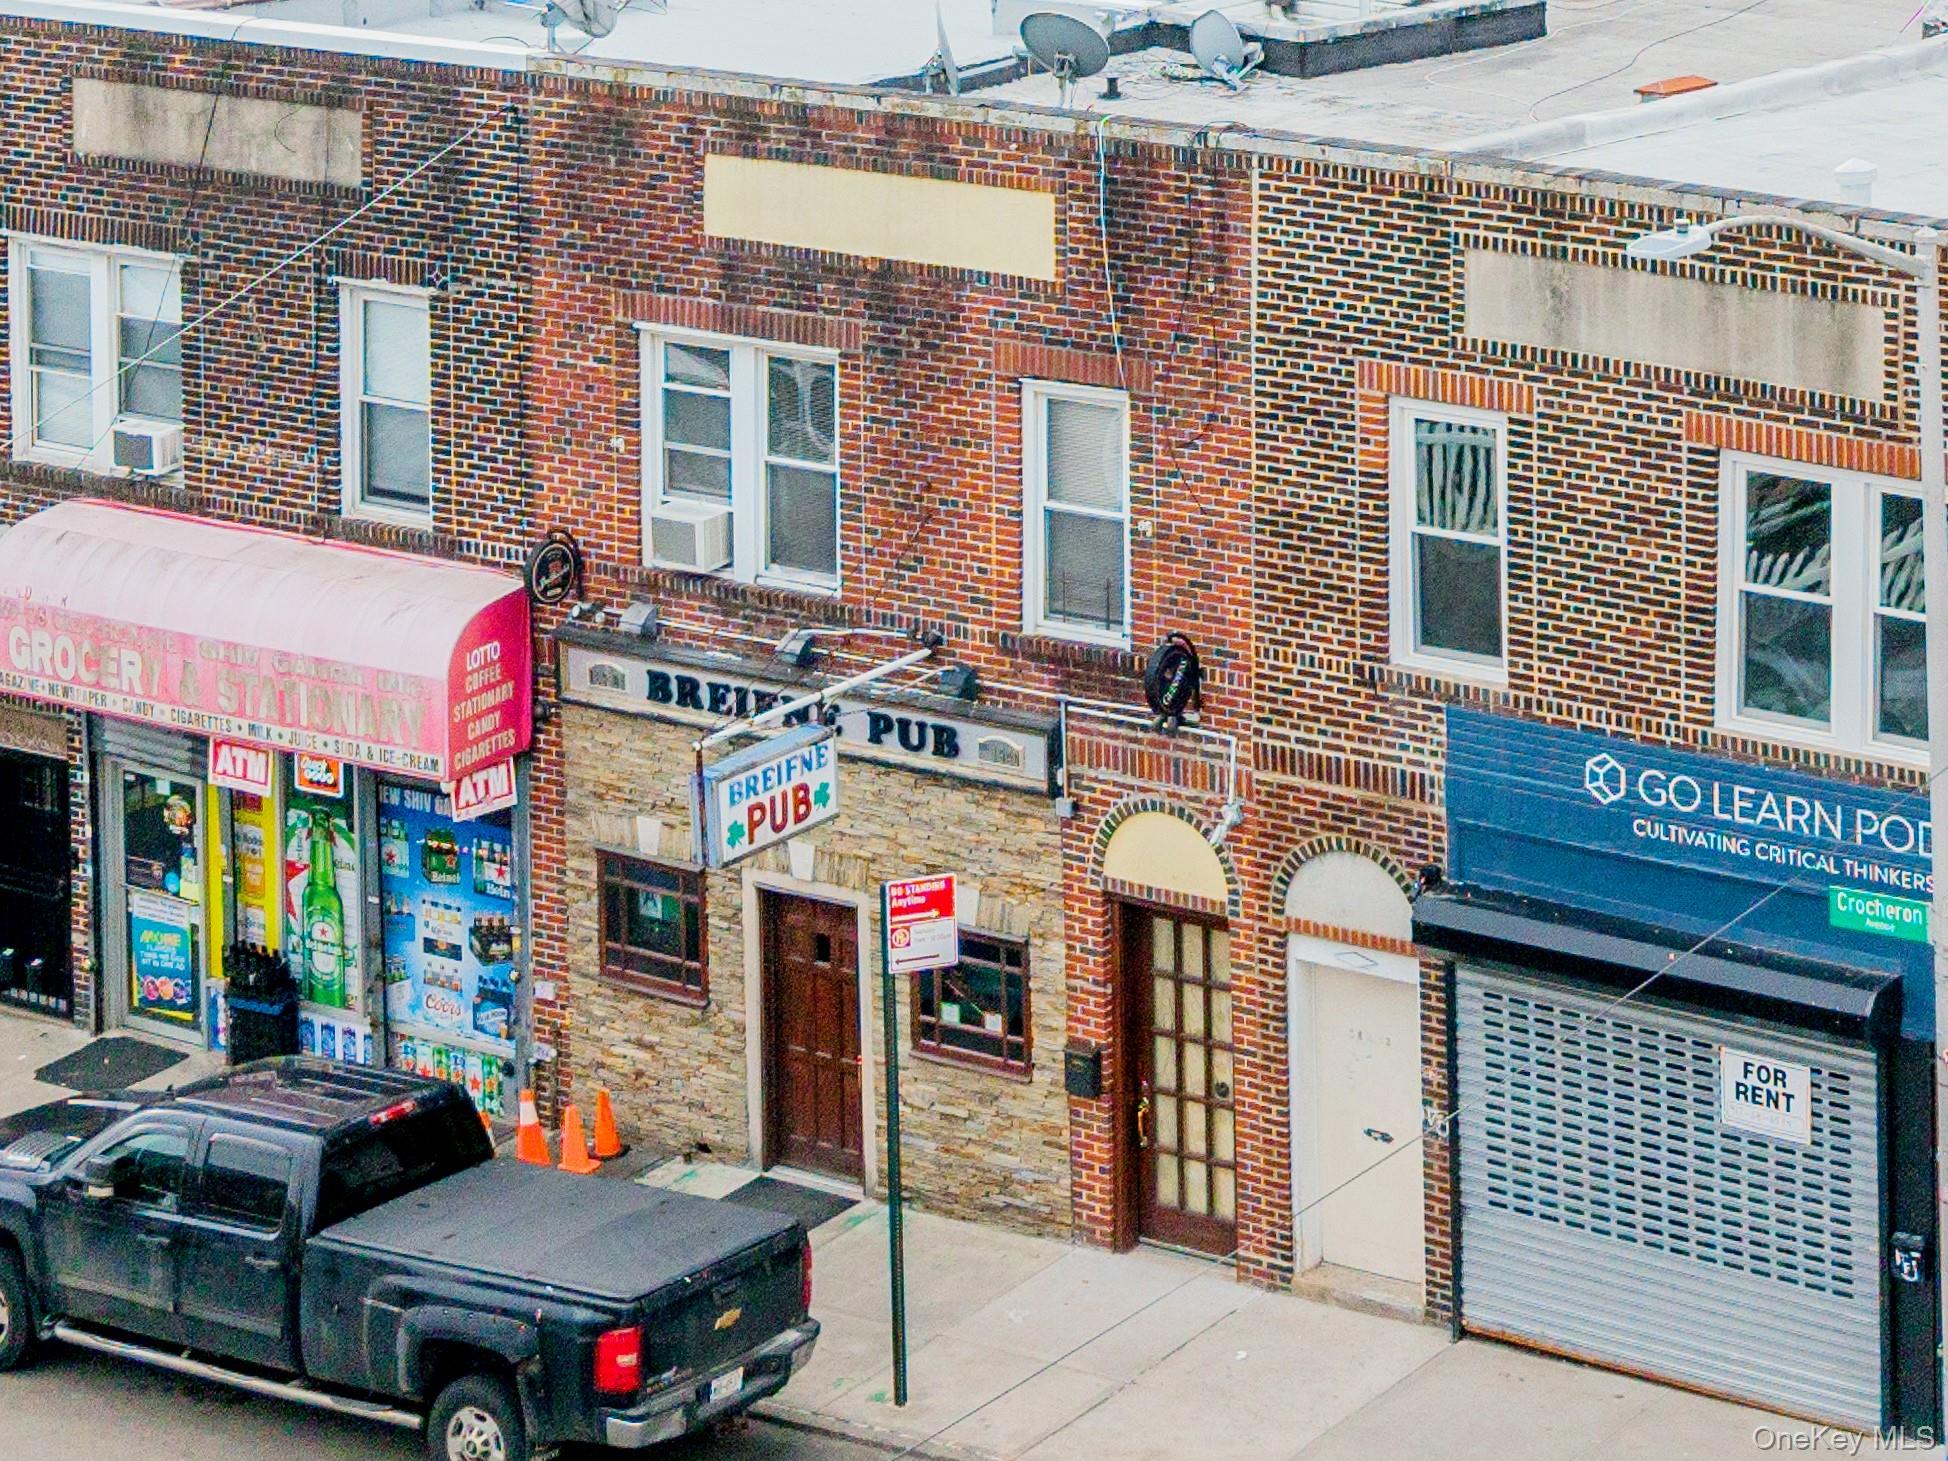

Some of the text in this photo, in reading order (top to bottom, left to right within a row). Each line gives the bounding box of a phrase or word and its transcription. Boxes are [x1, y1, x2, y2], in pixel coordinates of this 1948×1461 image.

[466, 640, 501, 671] LOTTO
[8, 625, 164, 697] GROCERY
[217, 667, 427, 748] STATIONARY
[465, 664, 502, 694] COFFEE
[453, 680, 515, 723] STATIONARY
[122, 698, 155, 719] CANDY
[170, 708, 232, 732] CIGARETTES
[288, 731, 318, 750] JUICE
[334, 739, 362, 759] SODA
[467, 711, 501, 741] CANDY
[866, 711, 960, 758] PUB
[215, 743, 268, 785] ATM
[454, 728, 516, 771] CIGARETTES
[458, 763, 509, 808] ATM
[728, 743, 829, 808] BREIFNE
[747, 782, 812, 845] PUB
[1638, 769, 1702, 812] GO
[1712, 781, 1842, 840] LEARN
[1633, 818, 1936, 893] CULTIVATING CRITICAL THINKERS
[1837, 891, 1923, 925] Crocheron
[1735, 1080, 1796, 1113] RENT
[1743, 1061, 1788, 1089] FOR
